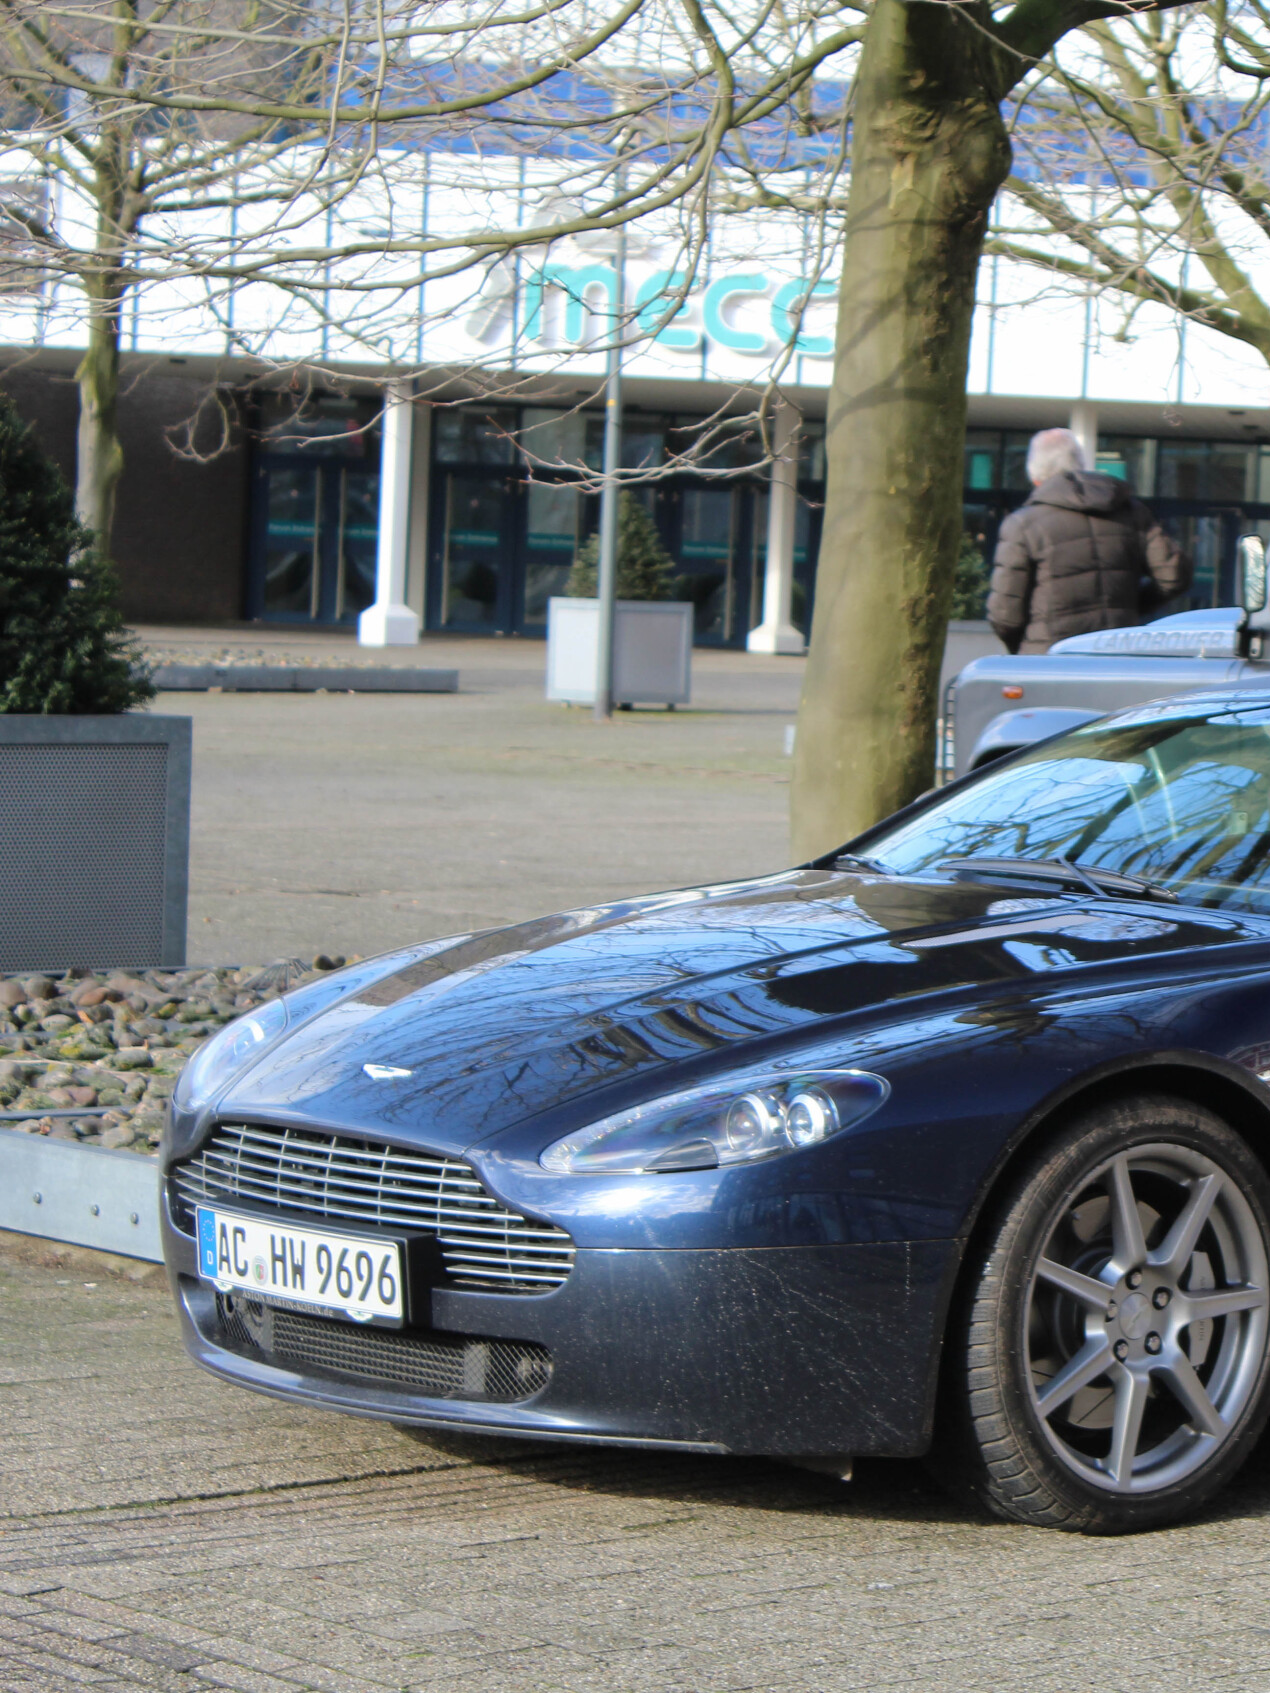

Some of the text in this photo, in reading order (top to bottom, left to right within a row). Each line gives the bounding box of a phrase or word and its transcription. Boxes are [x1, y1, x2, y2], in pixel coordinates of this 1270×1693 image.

[206, 1250, 213, 1265] D
[218, 1221, 396, 1305] AC HW 9696
